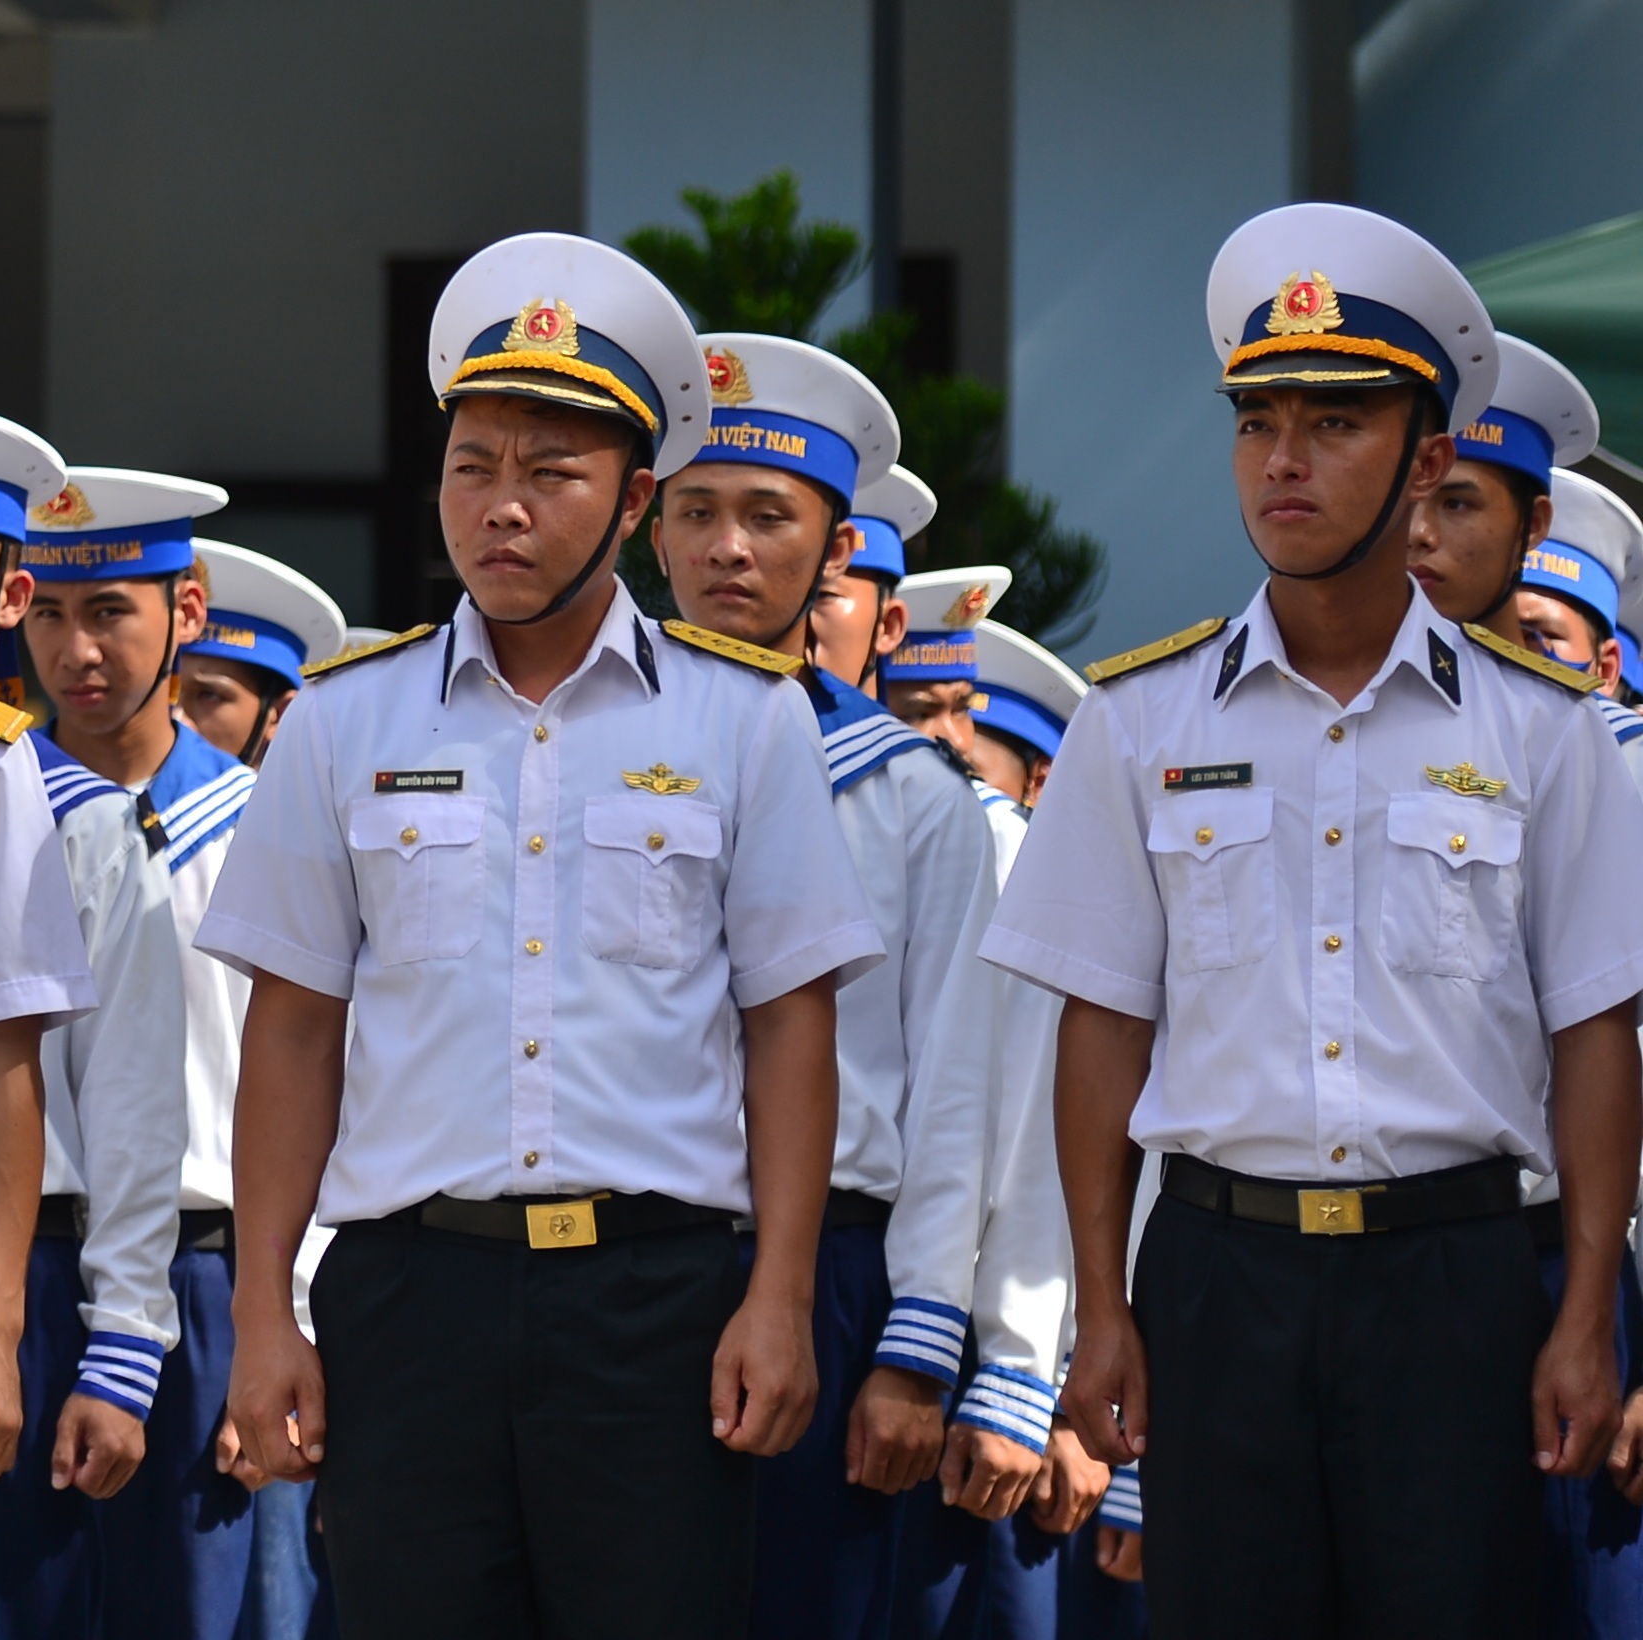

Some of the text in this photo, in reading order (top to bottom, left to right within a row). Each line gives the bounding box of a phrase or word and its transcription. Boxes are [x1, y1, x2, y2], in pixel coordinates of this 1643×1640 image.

[722, 422, 764, 451] VIỆT
[765, 429, 807, 459] NAM
[64, 540, 102, 568] VIỆT
[106, 540, 143, 563] NAM
[1542, 553, 1581, 582] NAM
